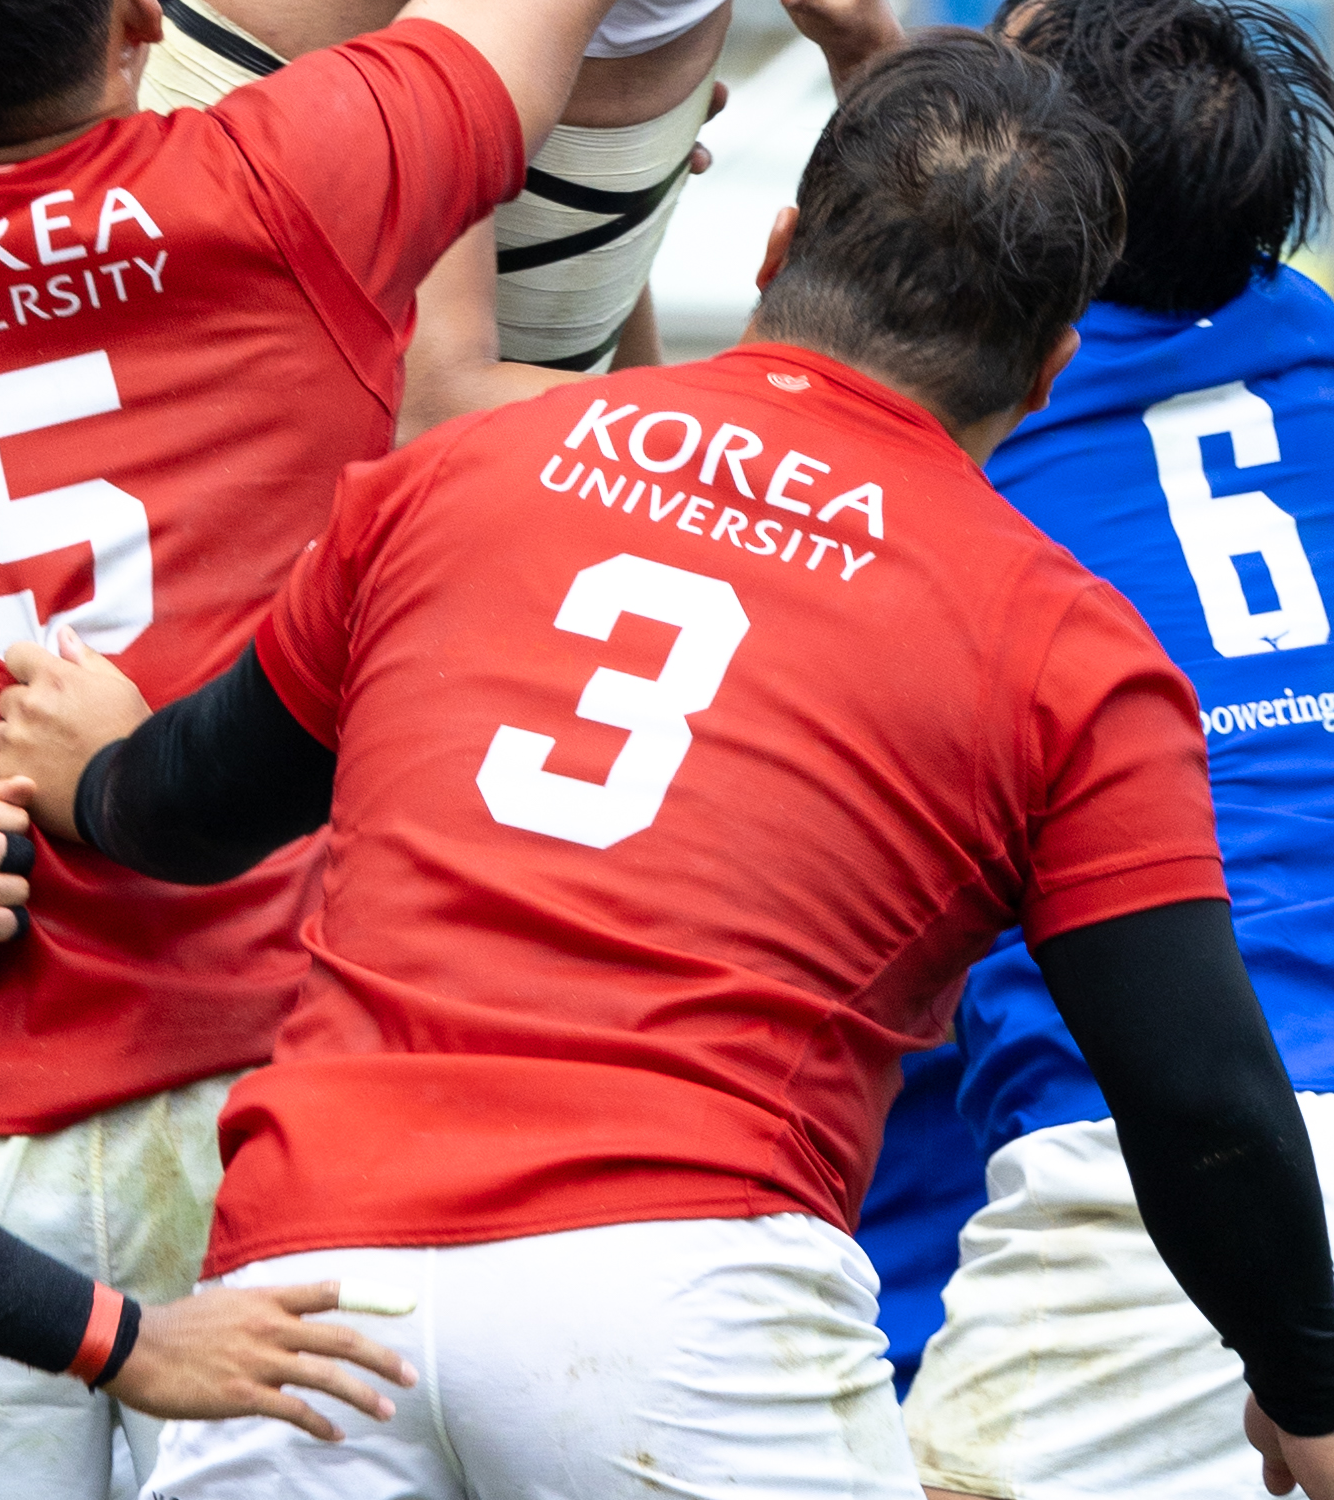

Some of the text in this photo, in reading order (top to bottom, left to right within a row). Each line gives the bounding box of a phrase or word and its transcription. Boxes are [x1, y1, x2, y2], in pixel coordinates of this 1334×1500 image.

[539, 455, 876, 582] UNIVERSITY
[563, 399, 884, 540] KOREA
[1142, 380, 1330, 658] 6
[475, 553, 751, 850] 3
